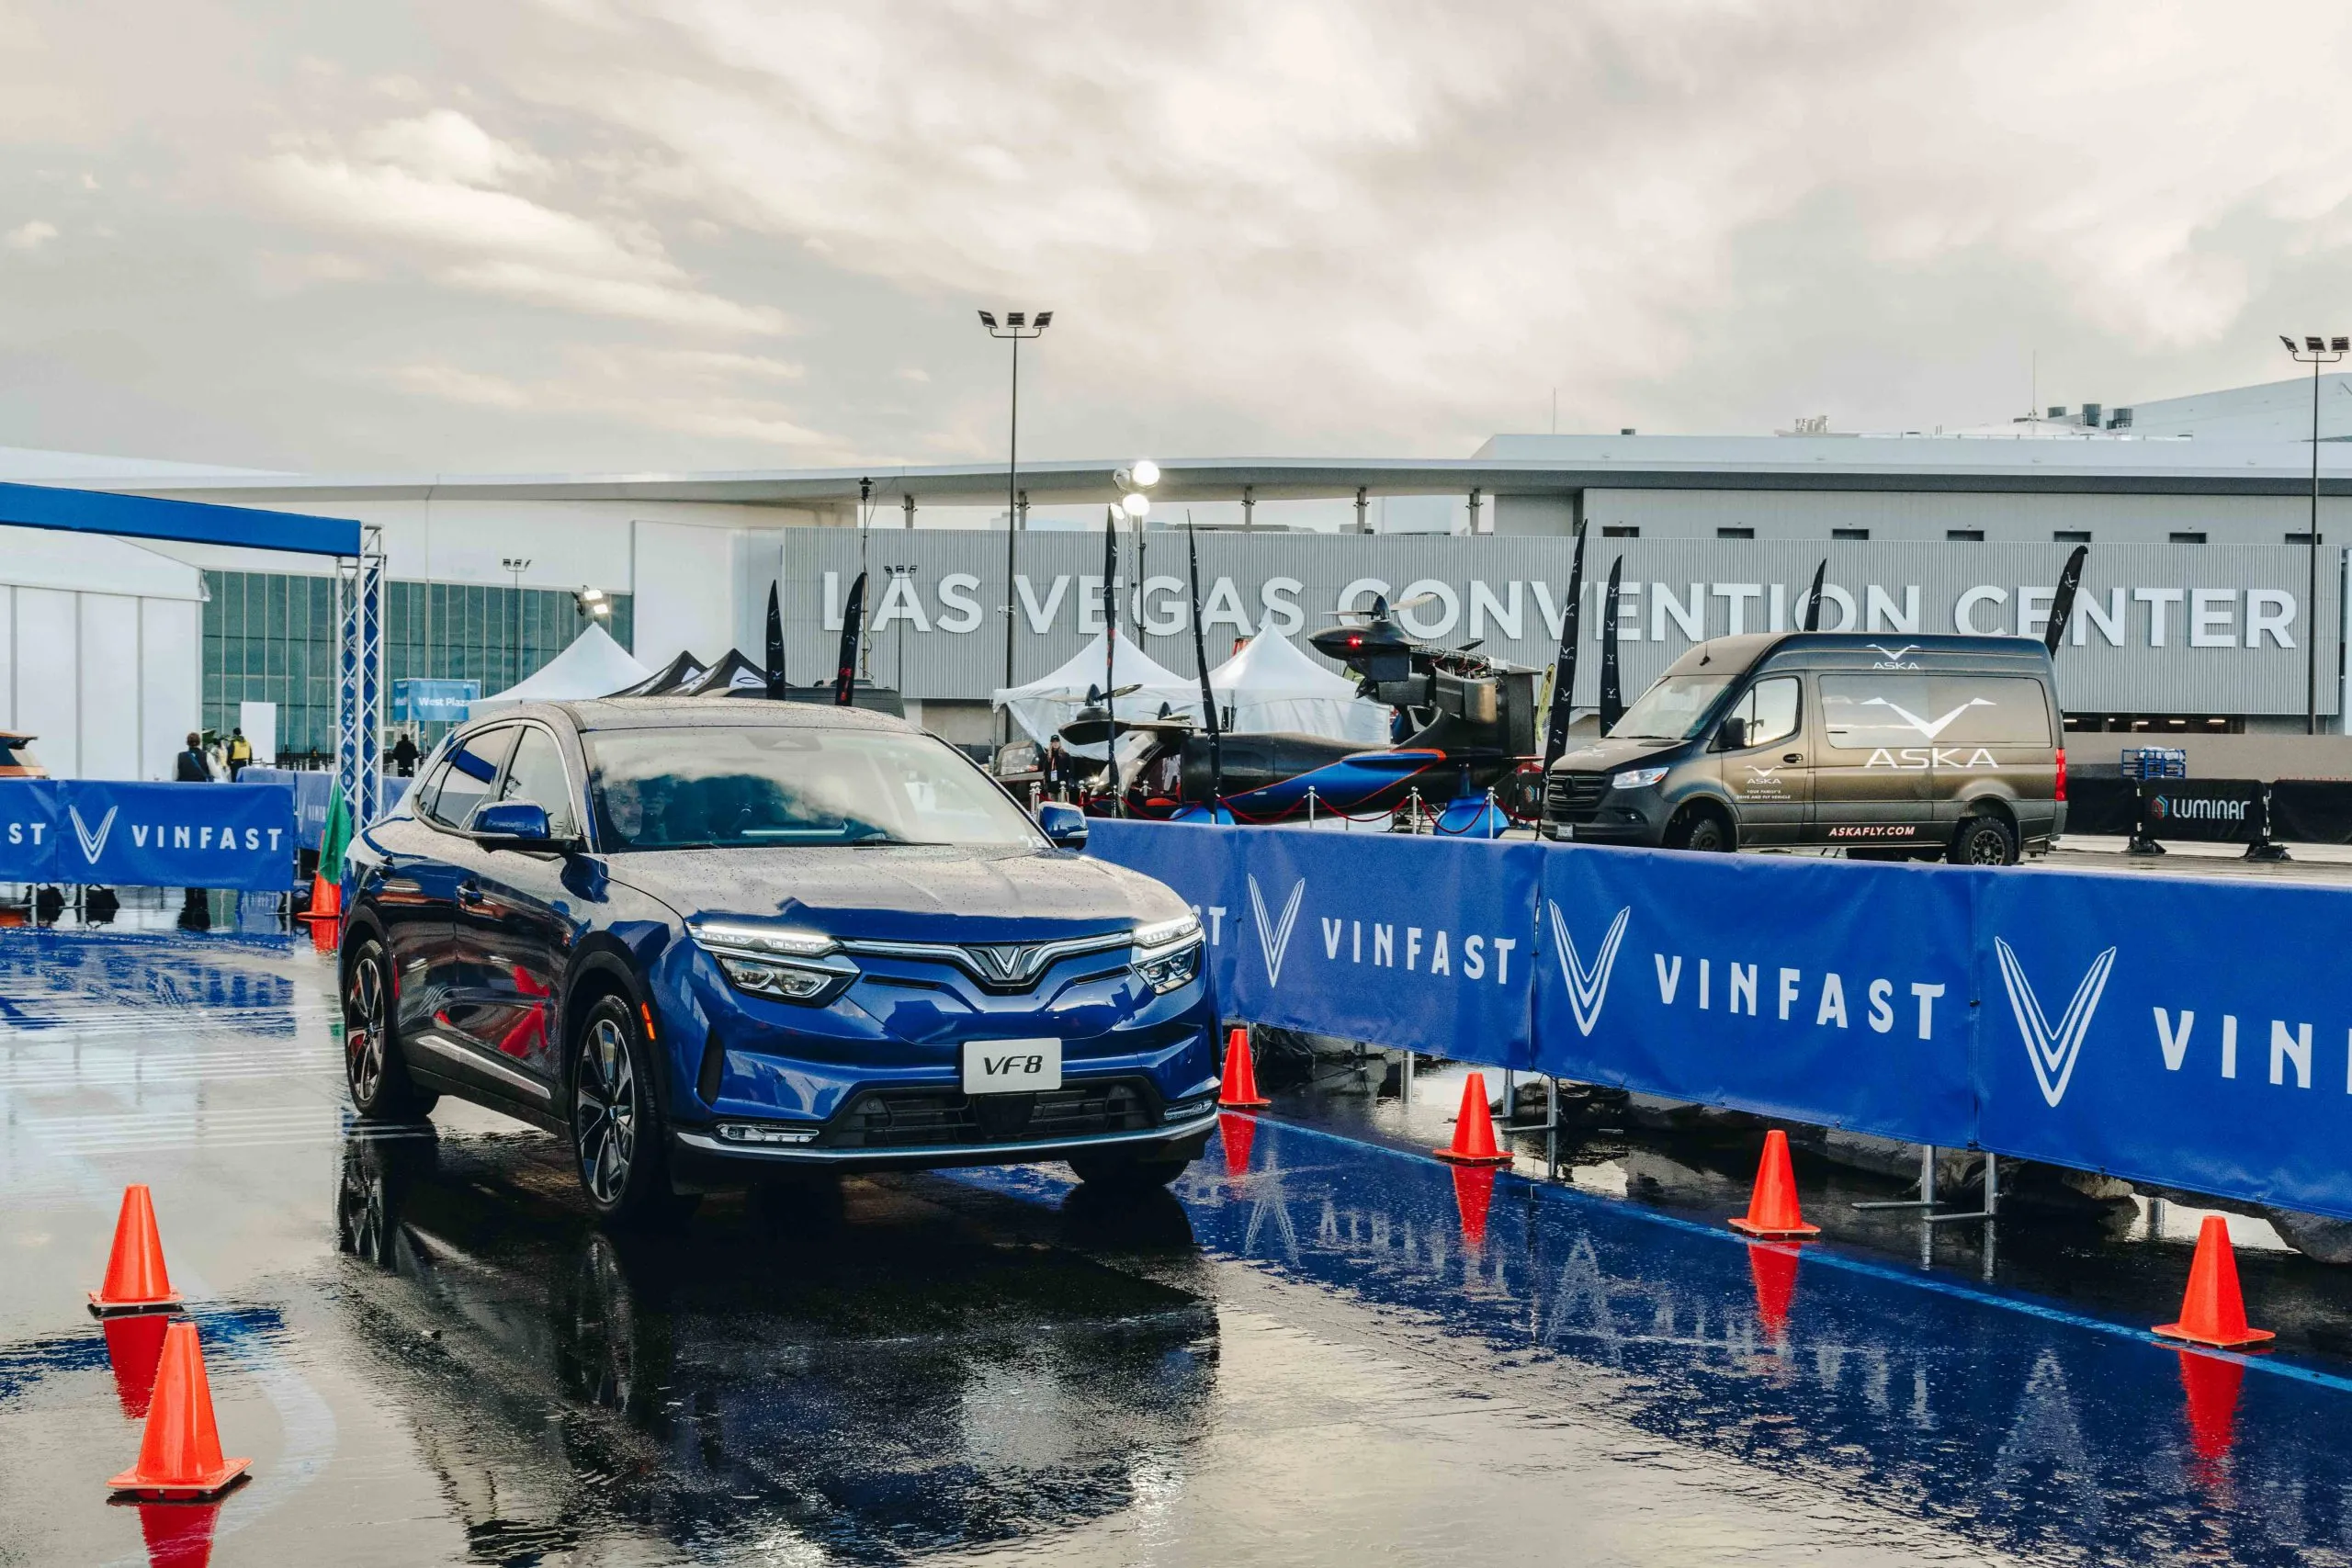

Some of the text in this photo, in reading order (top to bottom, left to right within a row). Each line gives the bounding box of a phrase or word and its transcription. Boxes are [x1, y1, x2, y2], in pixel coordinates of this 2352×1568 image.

[824, 570, 2297, 649] LAS VEGAS CONVENTION CENTER
[1872, 661, 1920, 670] ASKA
[418, 697, 444, 706] West
[1864, 748, 1999, 770] ASKA
[131, 825, 283, 852] VINFAST
[1828, 826, 1916, 837] ASKAFLY.COM
[1321, 917, 1517, 986] VINFAST
[1654, 953, 1946, 1041] VINFAST
[2154, 1006, 2352, 1095] VIN
